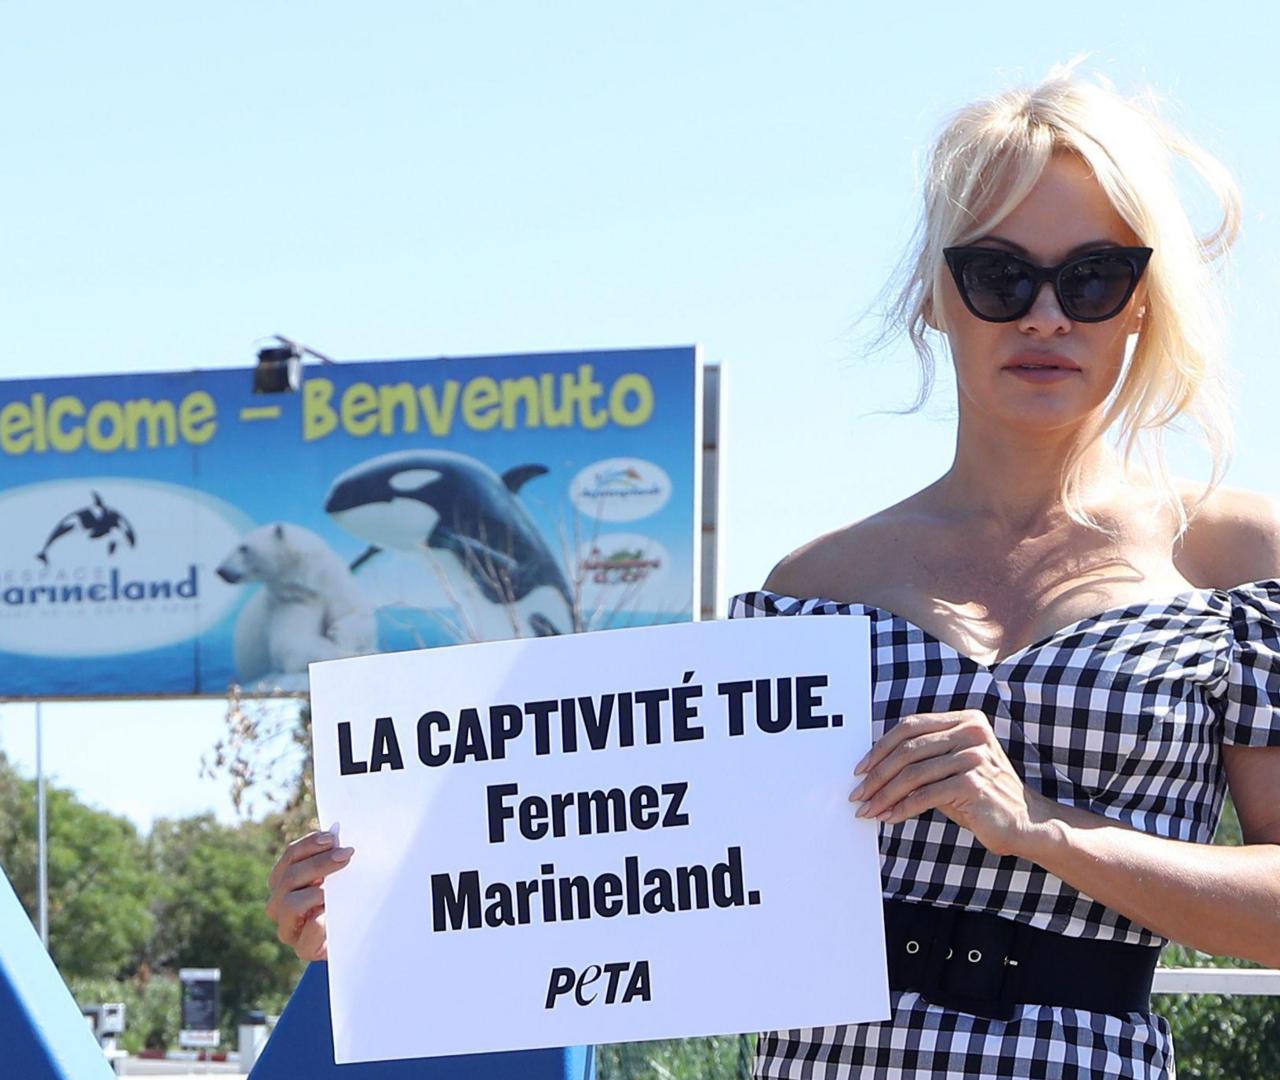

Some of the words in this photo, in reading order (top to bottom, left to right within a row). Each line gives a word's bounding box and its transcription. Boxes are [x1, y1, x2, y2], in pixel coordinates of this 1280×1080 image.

[303, 365, 654, 441] Benvenuto
[337, 717, 404, 776] LA
[416, 671, 704, 767] CAPTIVITÉ
[718, 674, 844, 736] TUE.
[486, 781, 690, 844] Fermez
[430, 846, 761, 932] Marineland.
